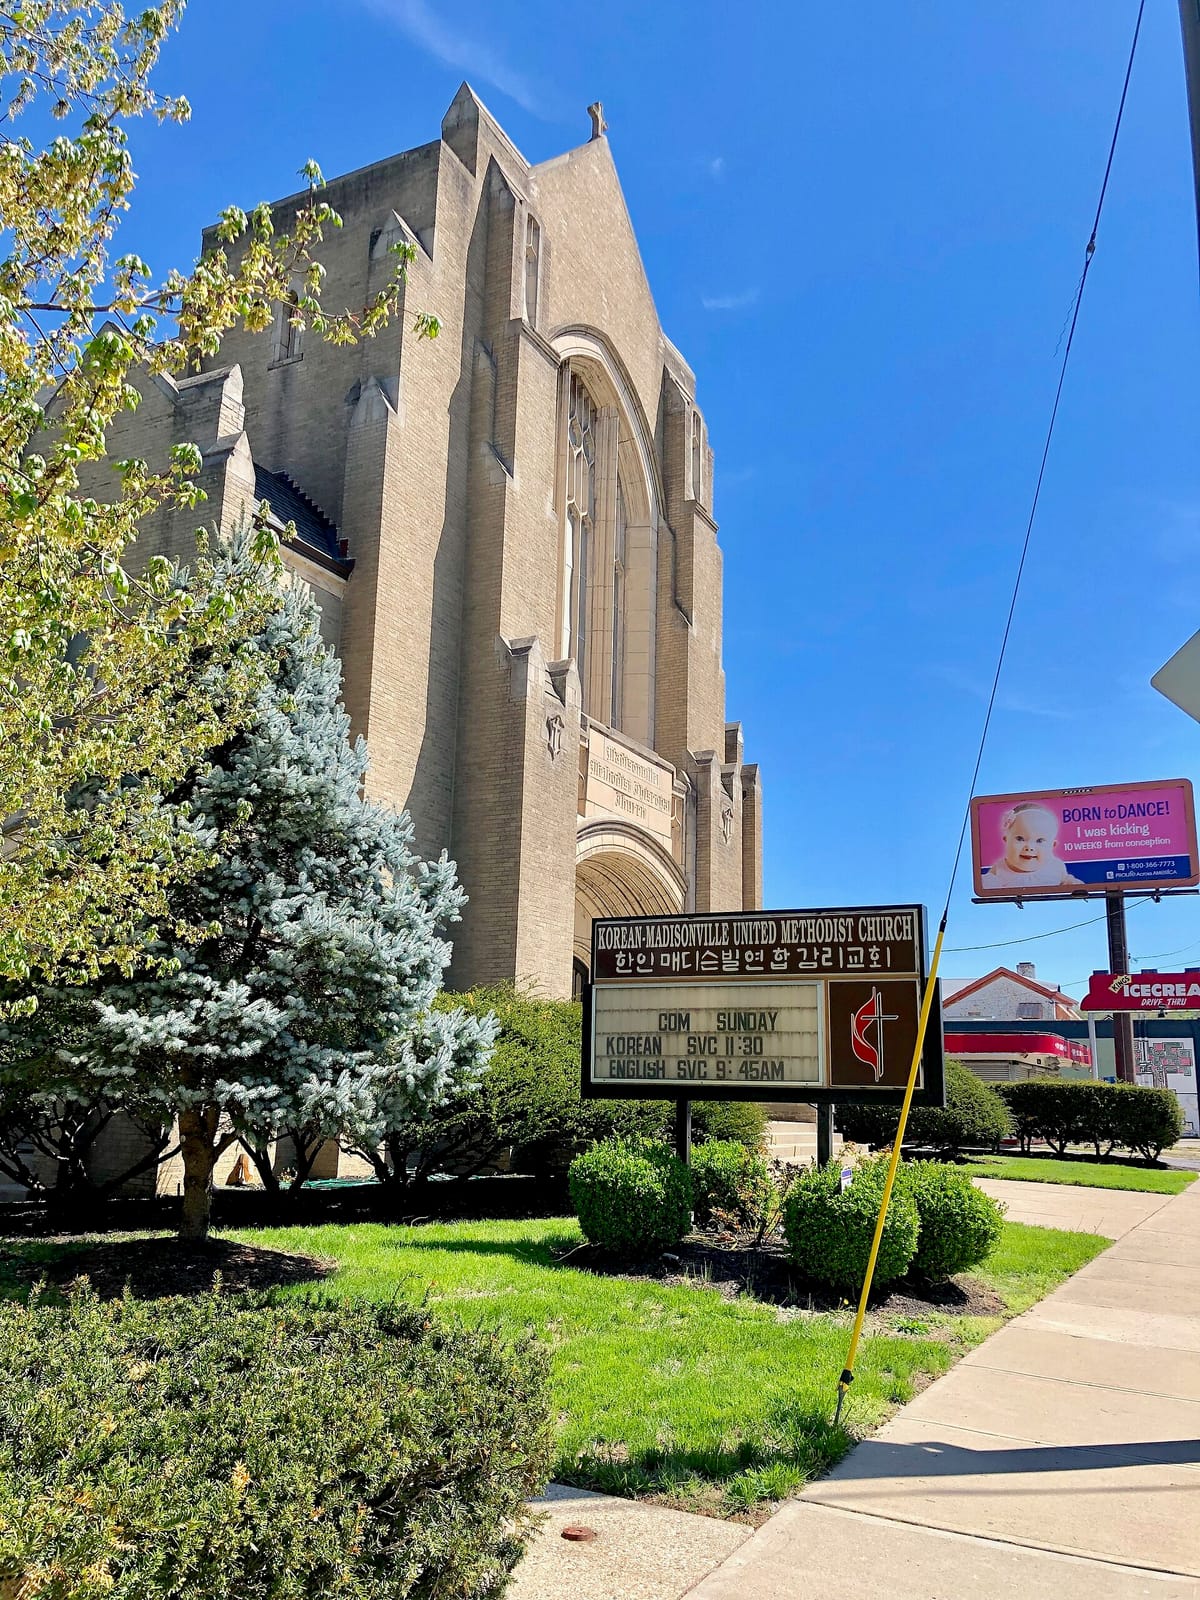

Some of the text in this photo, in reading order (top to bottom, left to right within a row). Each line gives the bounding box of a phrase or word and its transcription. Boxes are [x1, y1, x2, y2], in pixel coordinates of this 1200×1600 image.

[1062, 801, 1170, 823] BORN to DANCE!
[1076, 823, 1150, 838] I was kicking
[1063, 837, 1171, 851] 10 WEEKS from conception
[597, 914, 913, 950] KOREAN-MADISONVILLE UNITED METHODIST CHURCH
[615, 949, 655, 974] 한인
[796, 944, 892, 970] 감리교회
[1111, 975, 1130, 992] KINGS
[1141, 998, 1187, 1006] DRIVE THRU
[658, 1011, 779, 1032] COM SUNDAY
[606, 1036, 662, 1056] KOREAN
[687, 1036, 717, 1056] SVC
[609, 1059, 666, 1078] ENGLISH
[676, 1059, 707, 1079] SVC
